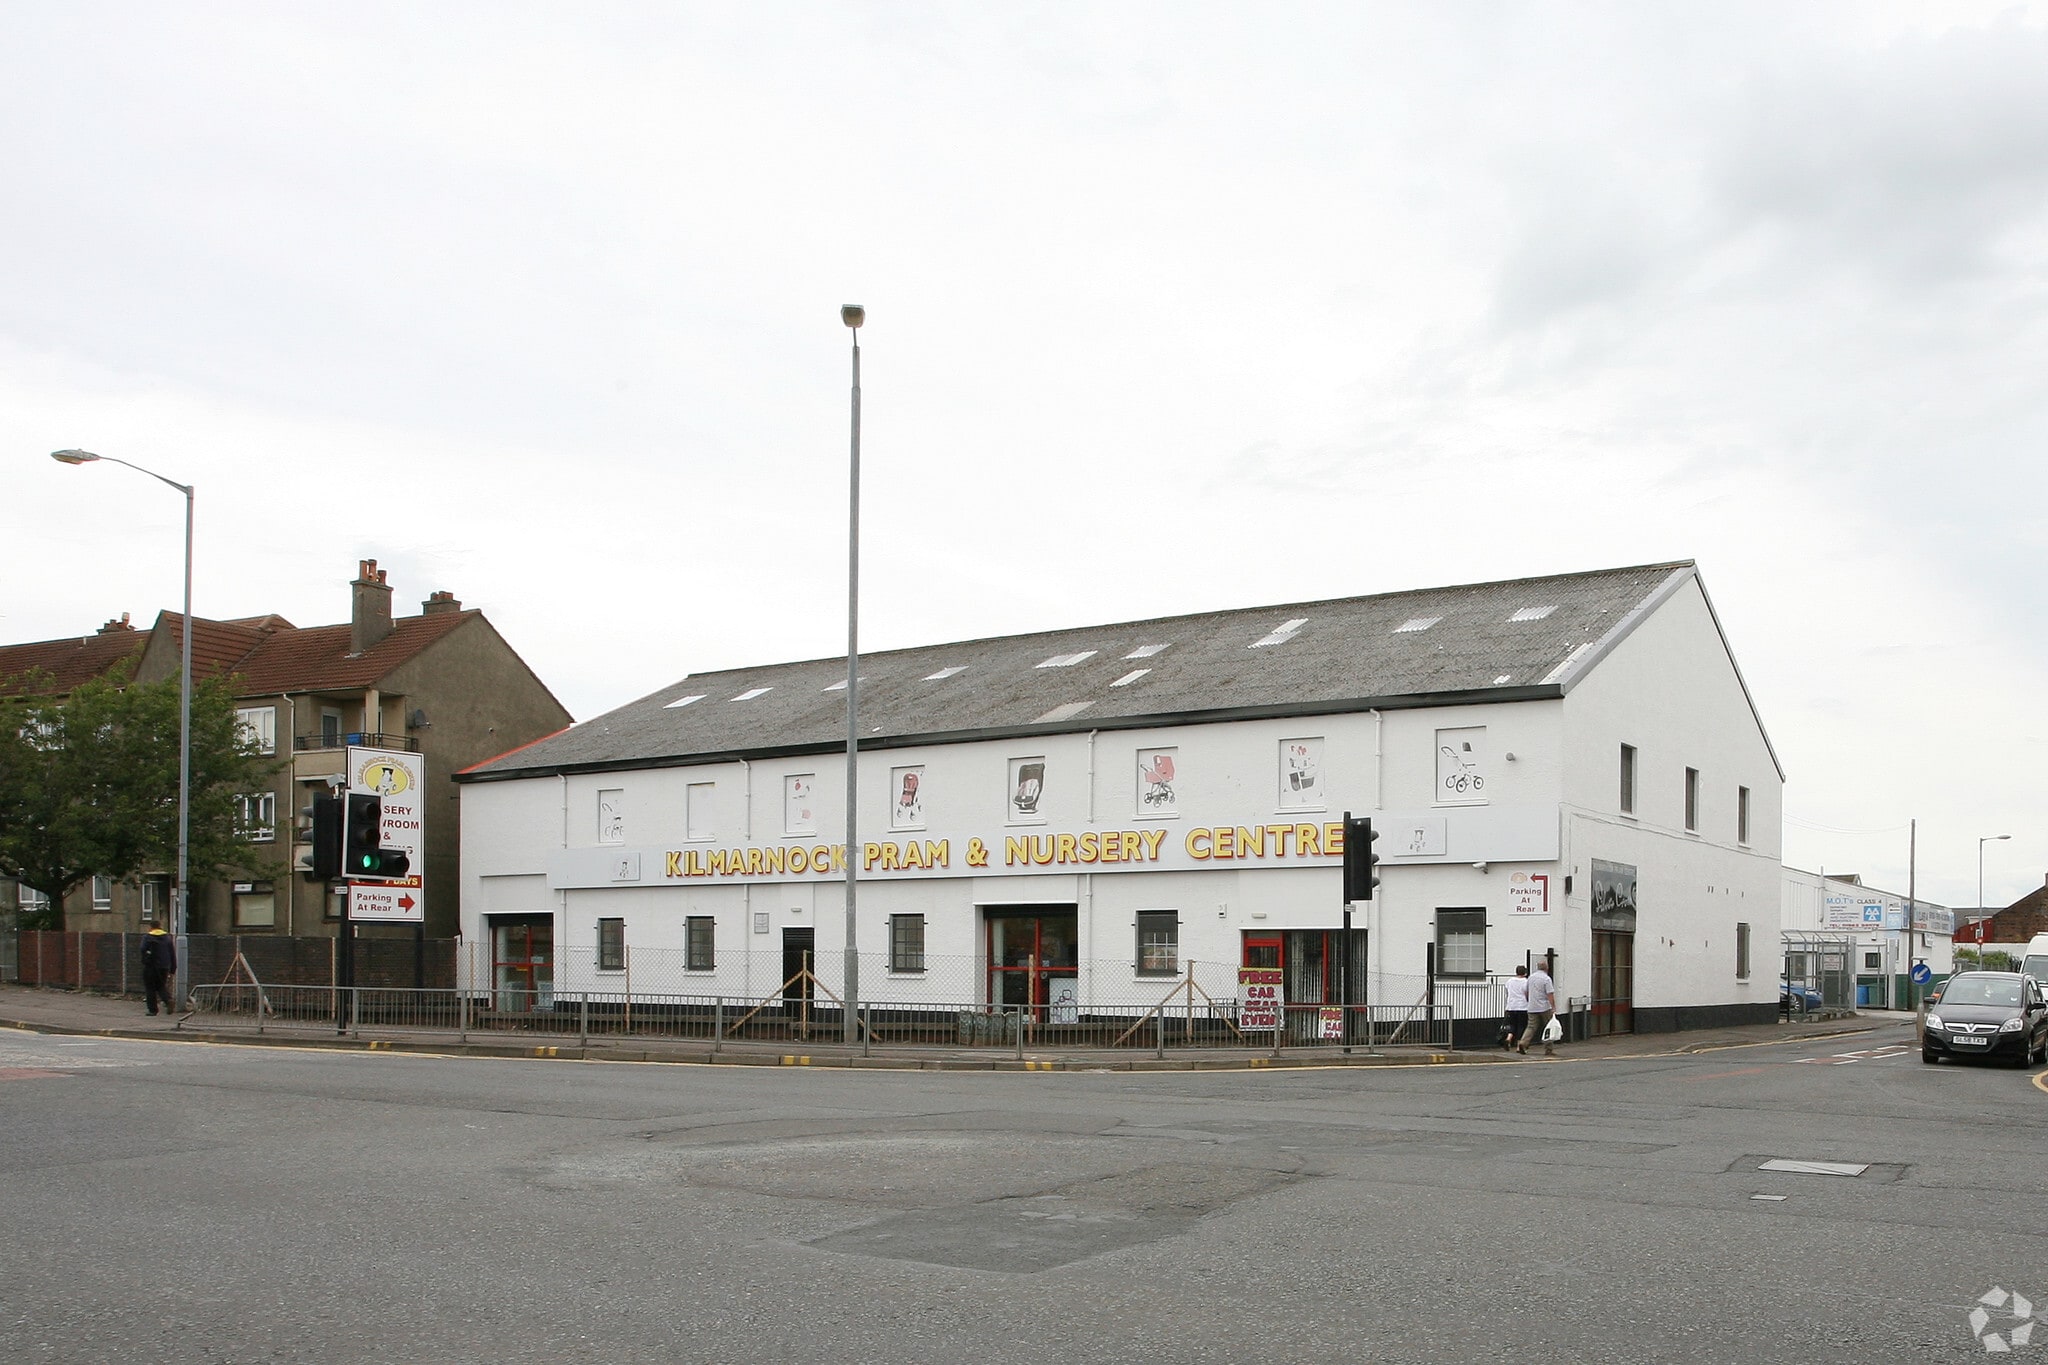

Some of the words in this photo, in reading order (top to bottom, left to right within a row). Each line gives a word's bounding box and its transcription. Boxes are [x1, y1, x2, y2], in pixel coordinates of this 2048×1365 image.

[383, 806, 412, 815] SERY
[383, 819, 420, 830] ROOM
[383, 832, 391, 840] &
[666, 843, 848, 877] KILMARNOCK
[863, 838, 950, 872] PRAM
[965, 837, 989, 868] &
[1005, 829, 1167, 865] NURSERY
[1185, 821, 1344, 859] CENTRE
[1510, 888, 1542, 896] Parking
[356, 893, 392, 903] Parking
[371, 904, 392, 912] Rear
[1239, 971, 1283, 984] FREE
[1248, 987, 1275, 998] CAR
